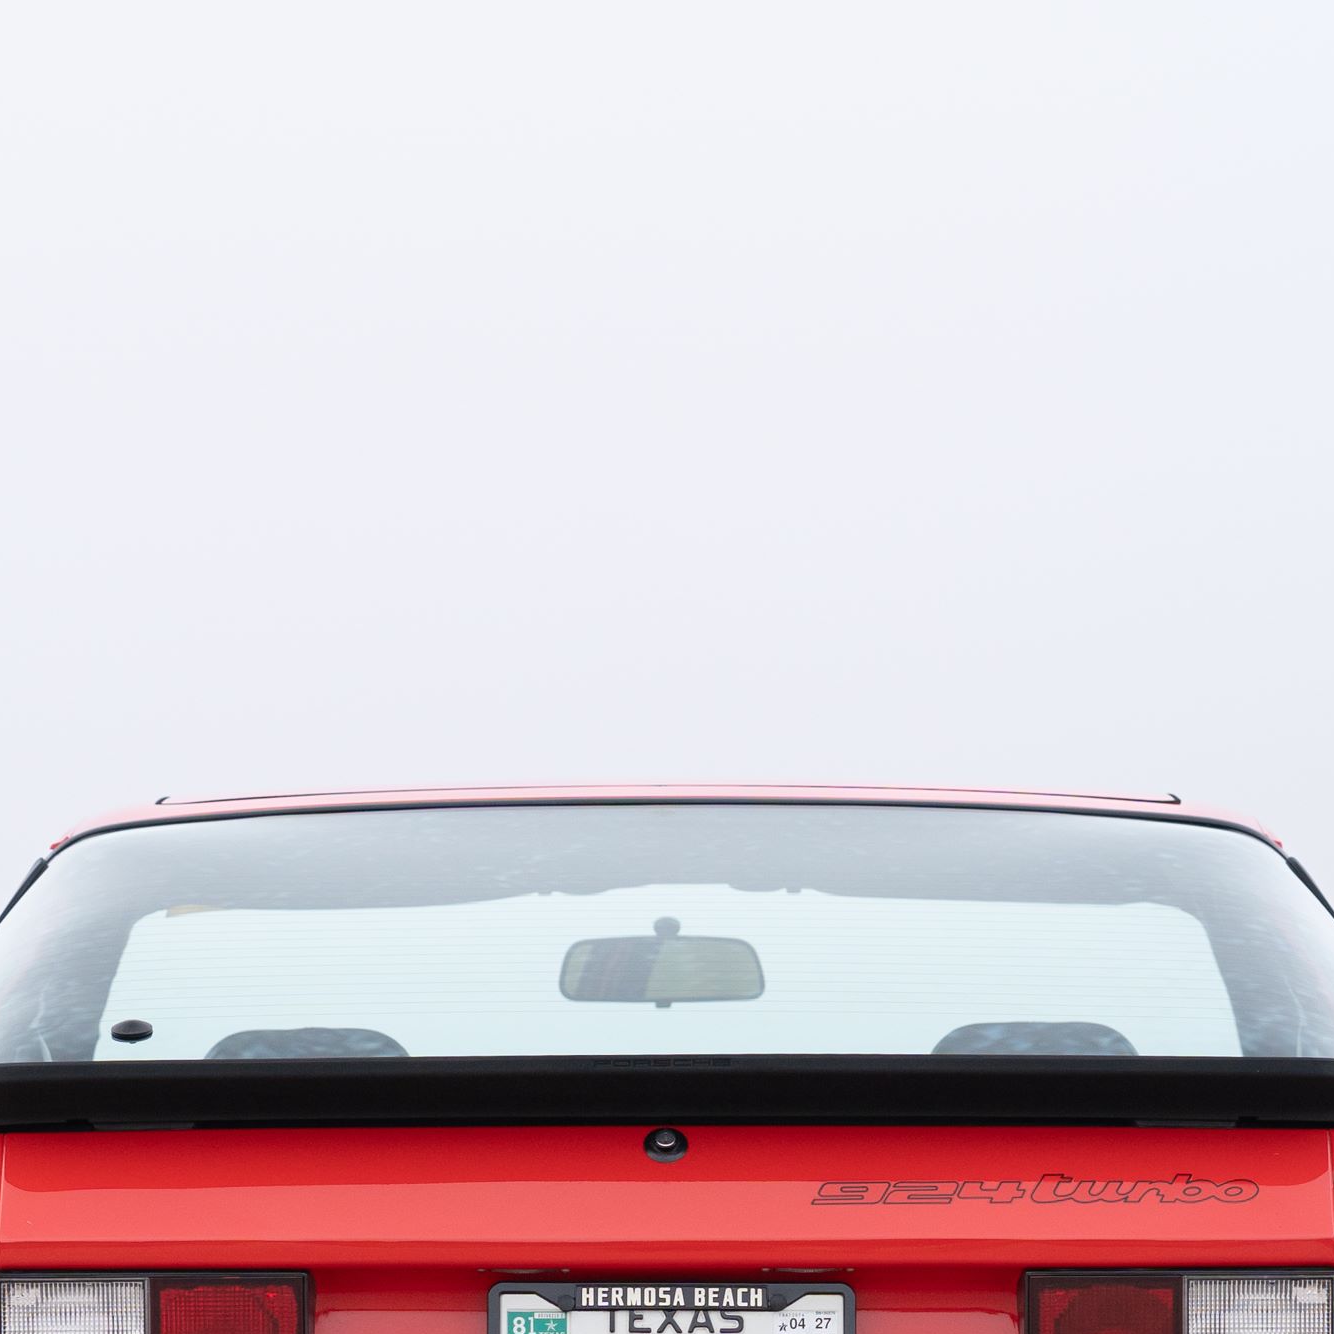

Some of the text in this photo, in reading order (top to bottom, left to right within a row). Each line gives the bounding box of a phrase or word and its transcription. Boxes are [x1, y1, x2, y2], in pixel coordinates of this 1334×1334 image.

[811, 1173, 1260, 1205] 924 turbo
[581, 1287, 763, 1307] HERMOSA BEACH
[789, 1317, 831, 1330] 04 27
